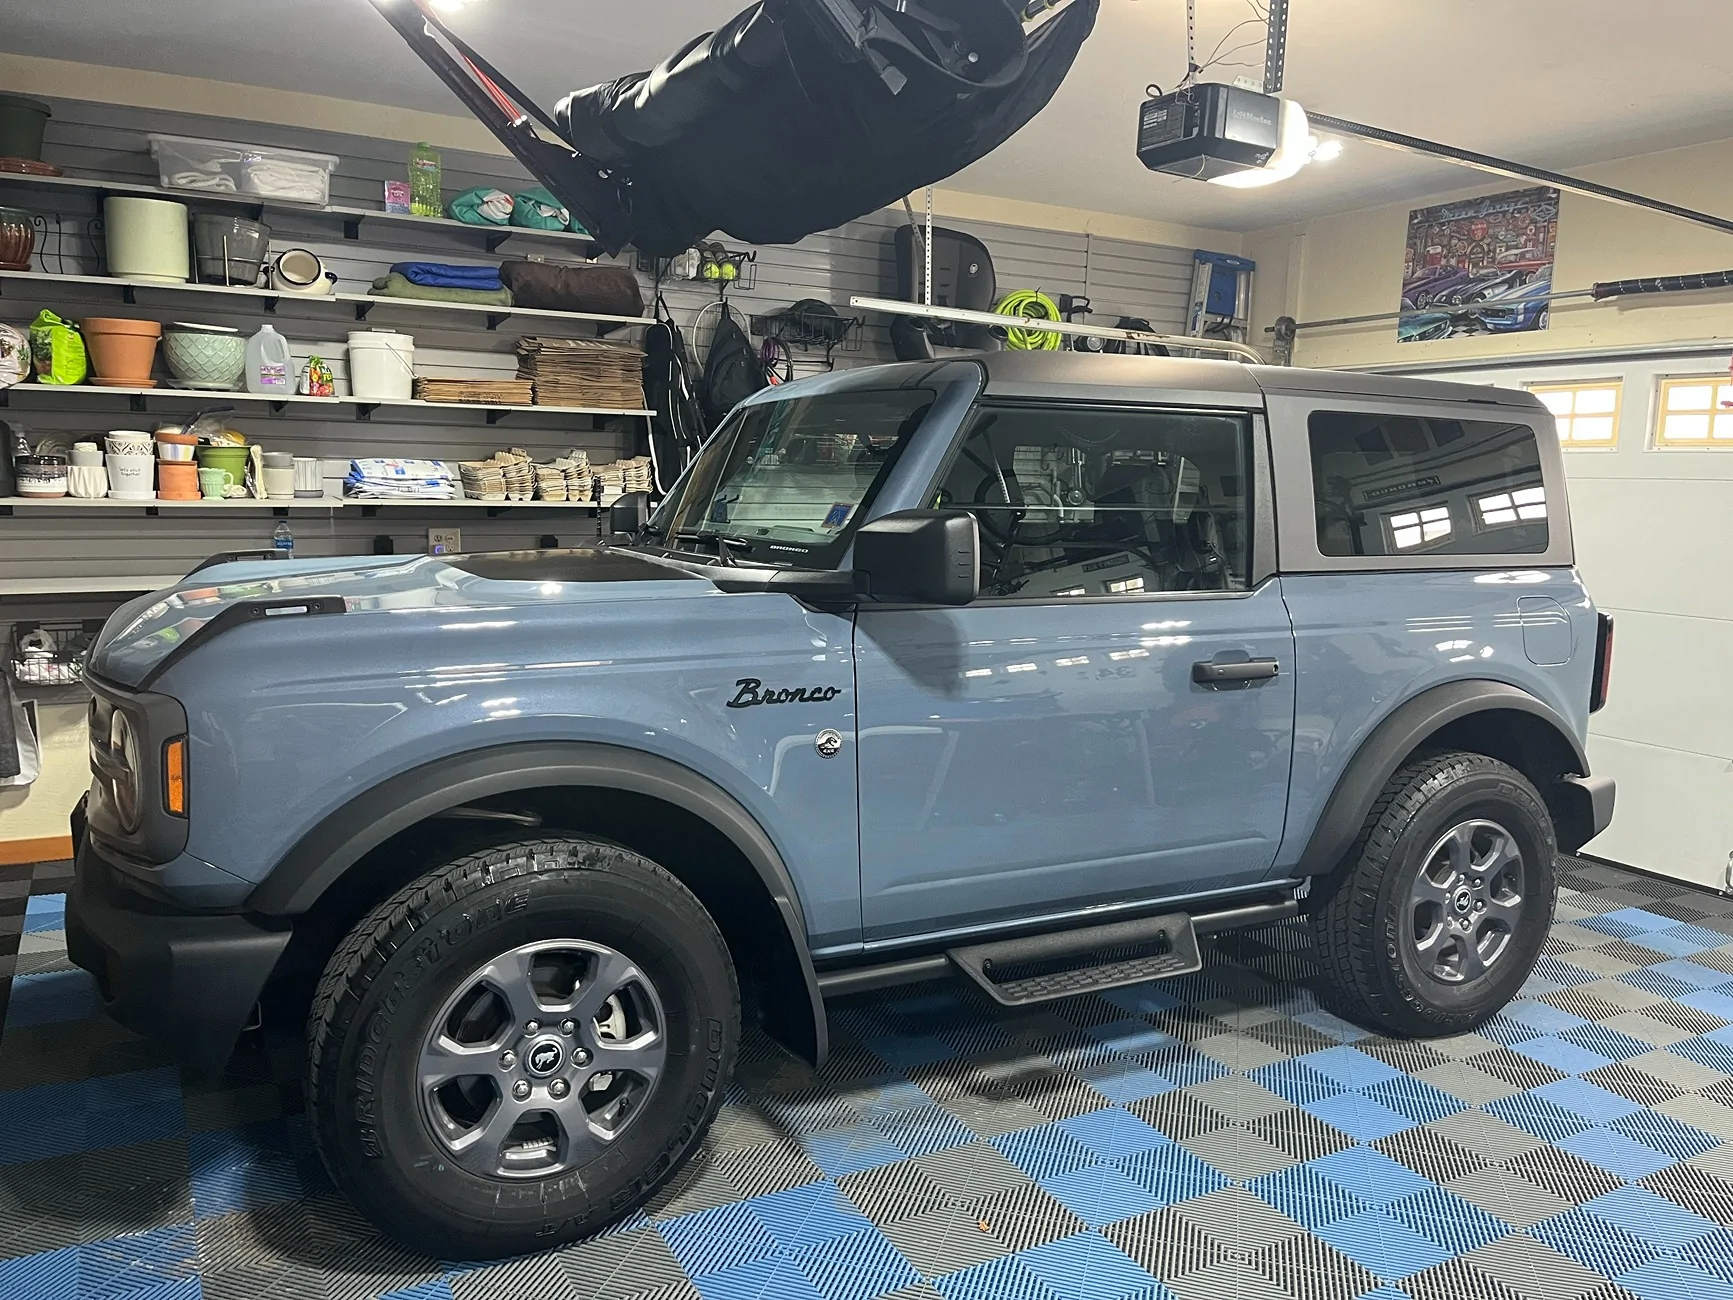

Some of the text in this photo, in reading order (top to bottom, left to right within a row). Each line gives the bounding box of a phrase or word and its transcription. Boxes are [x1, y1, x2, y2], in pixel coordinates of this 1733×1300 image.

[1479, 199, 1525, 217] Garage
[769, 544, 809, 554] BRONCO
[725, 677, 842, 709] Bronco
[609, 1017, 723, 1211] DUELER
